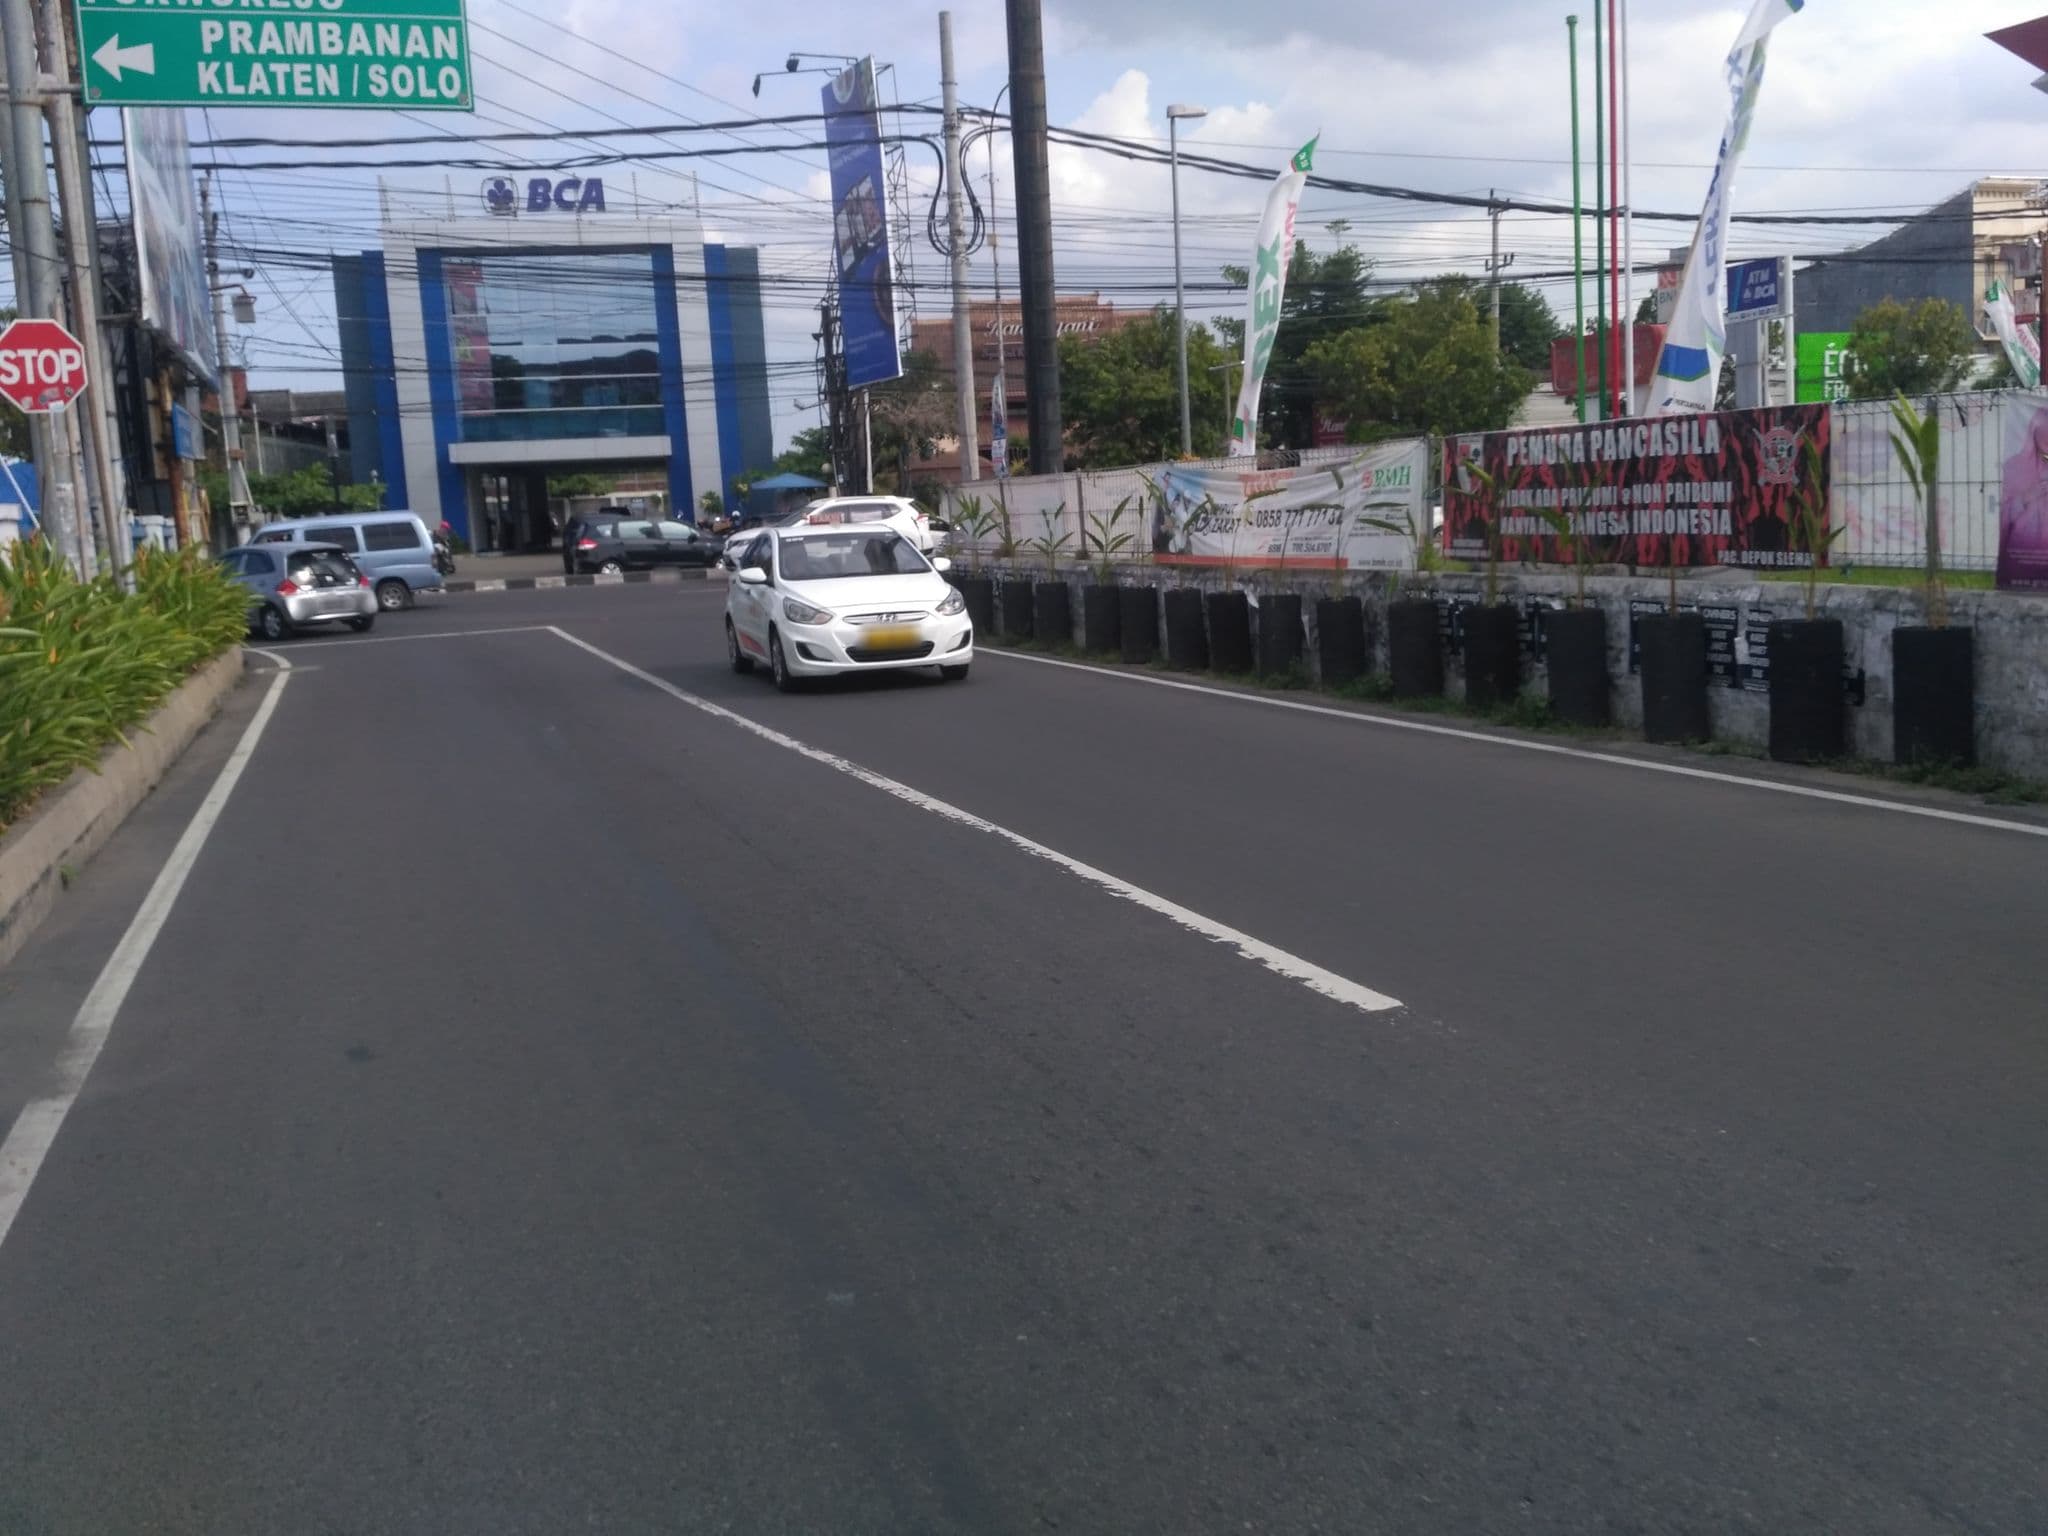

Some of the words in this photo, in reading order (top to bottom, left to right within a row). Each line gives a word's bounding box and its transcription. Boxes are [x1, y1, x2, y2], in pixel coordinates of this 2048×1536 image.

[201, 20, 459, 60] PRAMBANAN
[197, 61, 341, 97] KLATEN
[368, 64, 462, 99] SOLO
[526, 177, 606, 212] BCA
[0, 348, 81, 385] STOP
[1506, 431, 1585, 467] PEMUDA
[1590, 418, 1721, 463] PANCASILA
[1632, 484, 1662, 504] NON
[1665, 480, 1734, 504] PRIBUMI
[1256, 510, 1281, 529] 0858
[1632, 508, 1733, 536] INDONESIA
[1741, 550, 1774, 566] DEPOK
[1775, 551, 1816, 567] SLEMA
